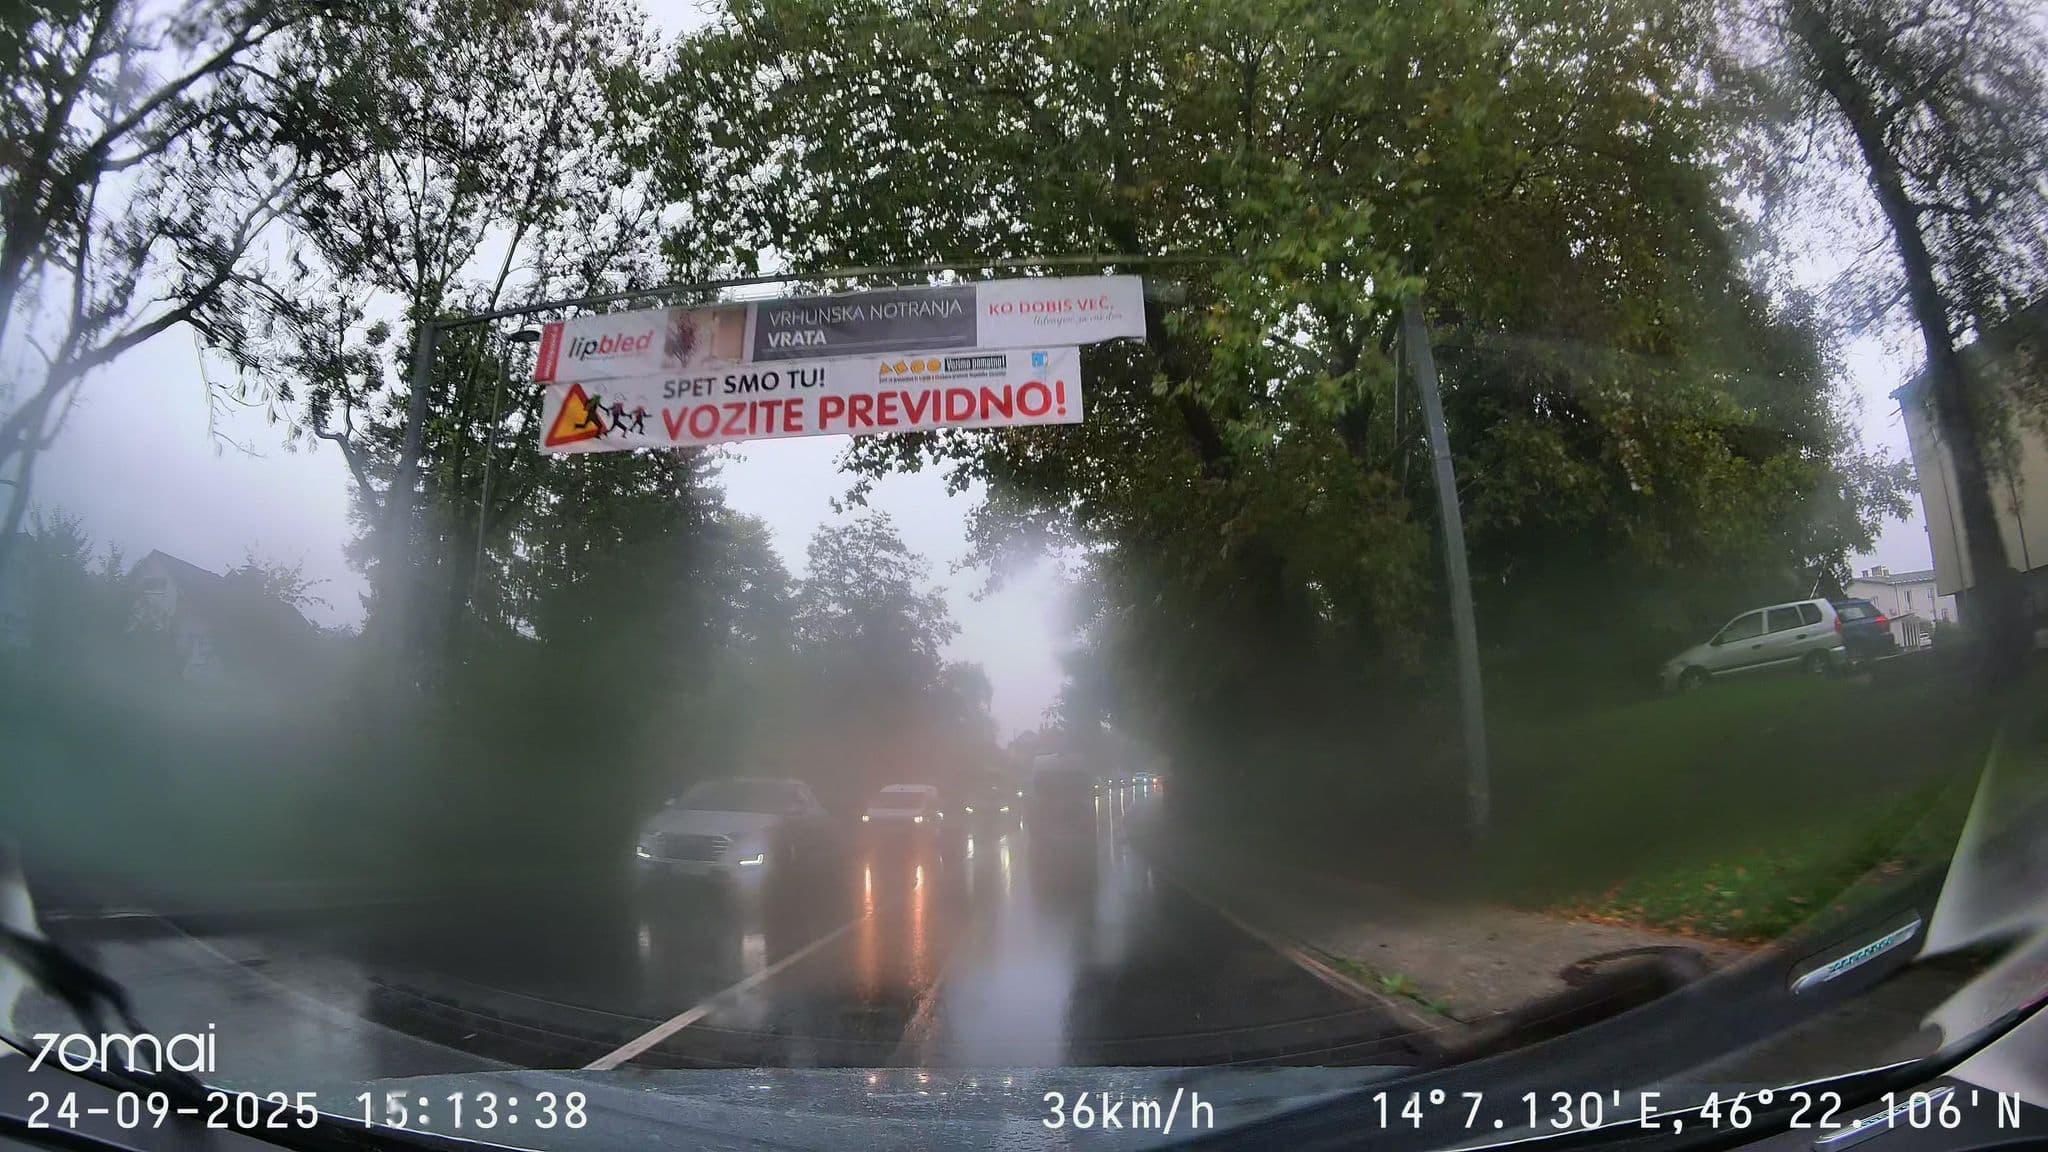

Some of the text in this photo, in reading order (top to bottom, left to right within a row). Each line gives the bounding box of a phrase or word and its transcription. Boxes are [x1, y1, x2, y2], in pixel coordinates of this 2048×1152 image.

[769, 299, 962, 327] VRHUNSKA NOTRANJA
[989, 303, 1013, 316] KO
[568, 331, 655, 361] lipbled
[768, 329, 826, 348] VRATA
[663, 368, 825, 399] SPET SMO TU!
[661, 379, 1067, 441] VOZITE PREVIDNO!
